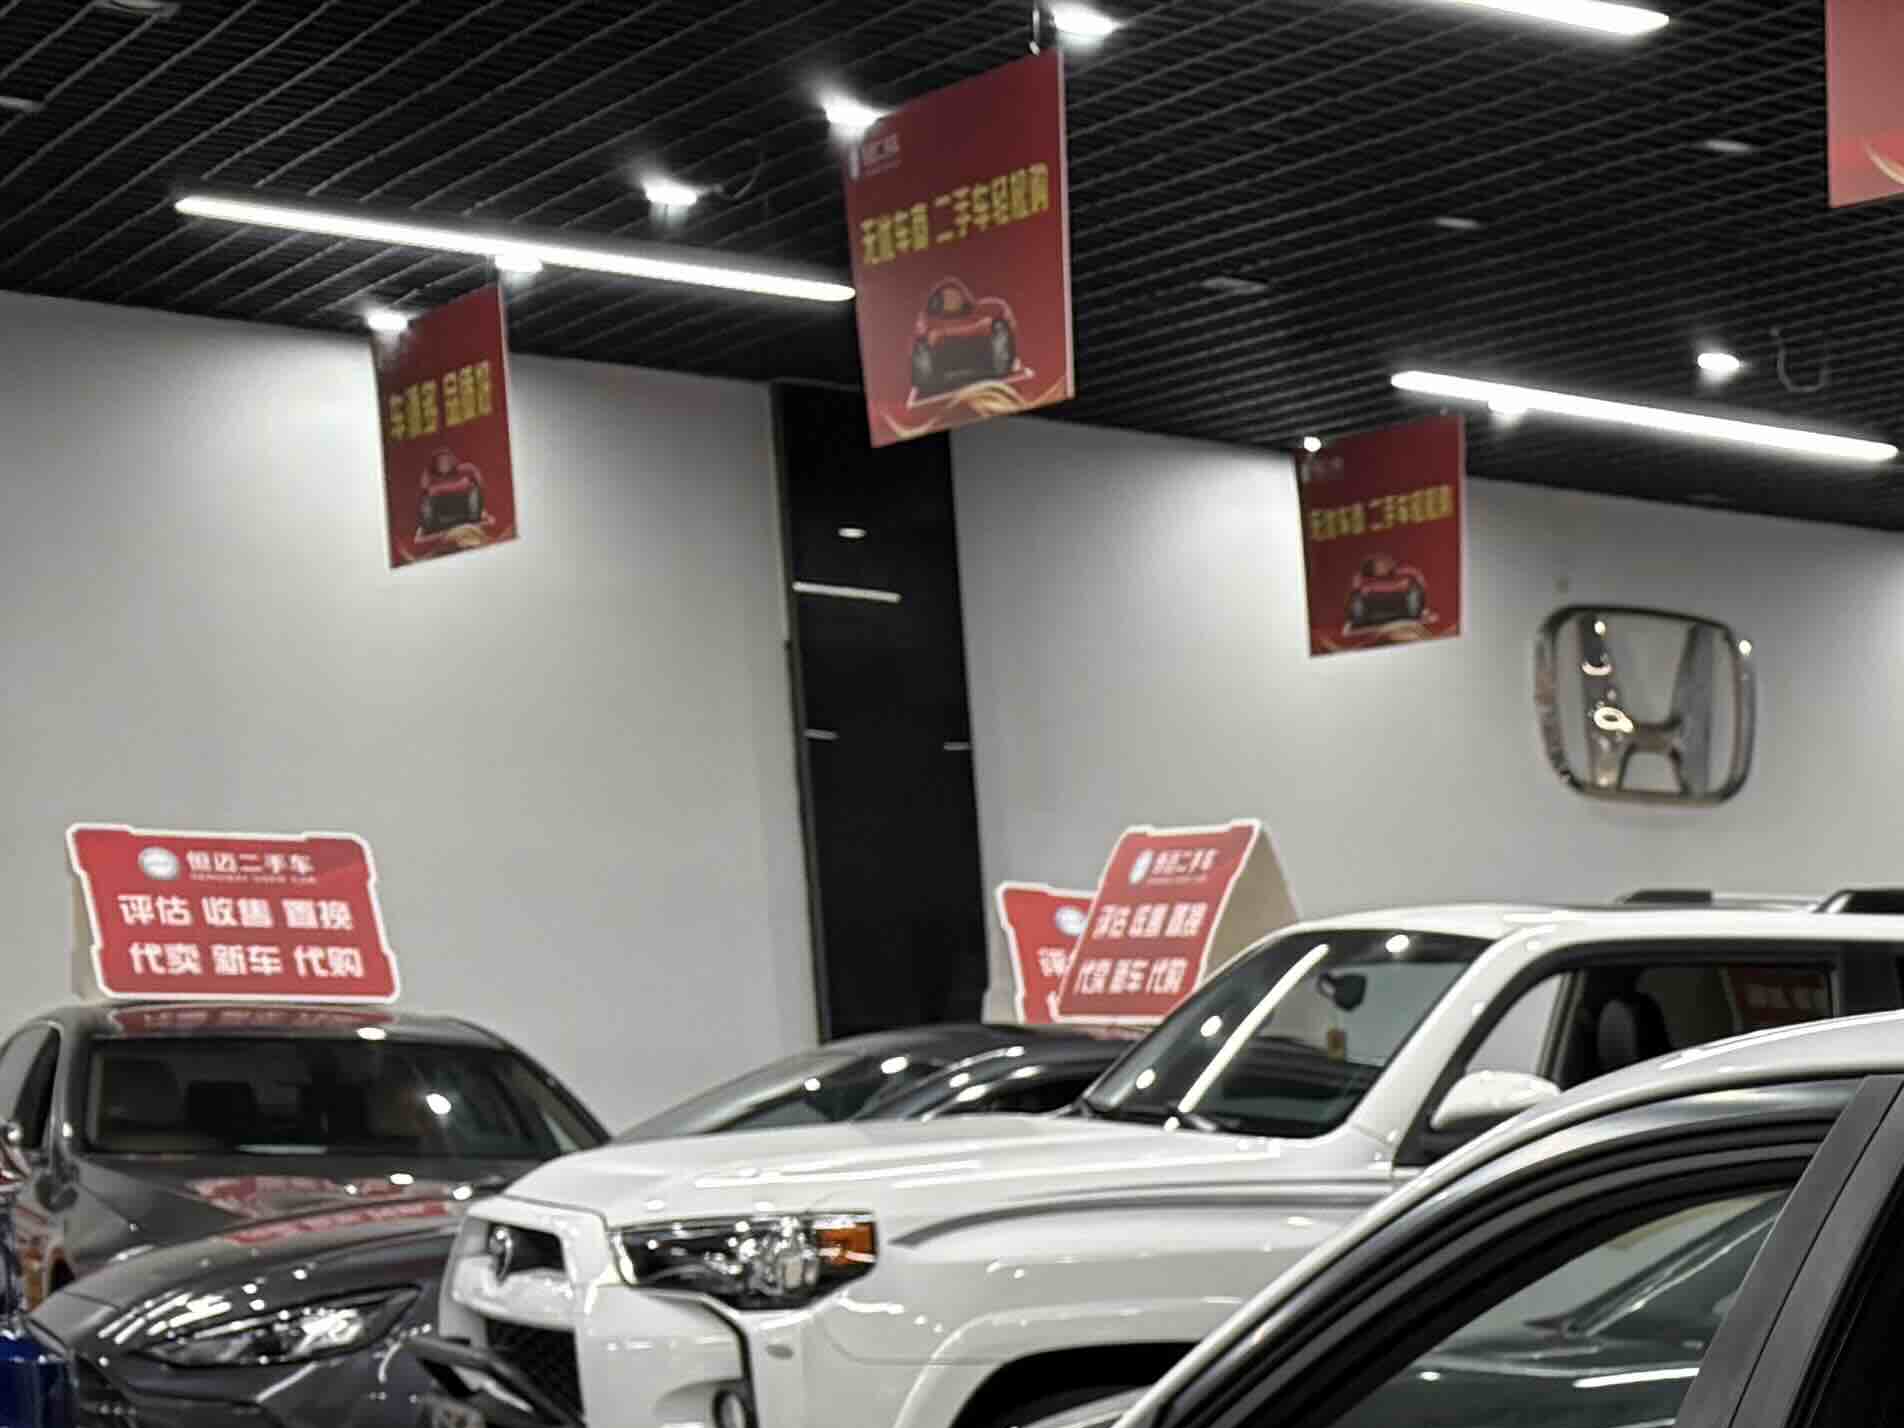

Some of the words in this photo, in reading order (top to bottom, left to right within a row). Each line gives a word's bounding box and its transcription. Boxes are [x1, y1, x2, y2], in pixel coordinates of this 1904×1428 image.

[117, 894, 194, 927] 评估
[200, 896, 275, 929] 收售
[282, 898, 355, 930] 置换
[128, 941, 203, 976] 代卖
[210, 943, 284, 977] 新车
[293, 944, 365, 979] 代购
